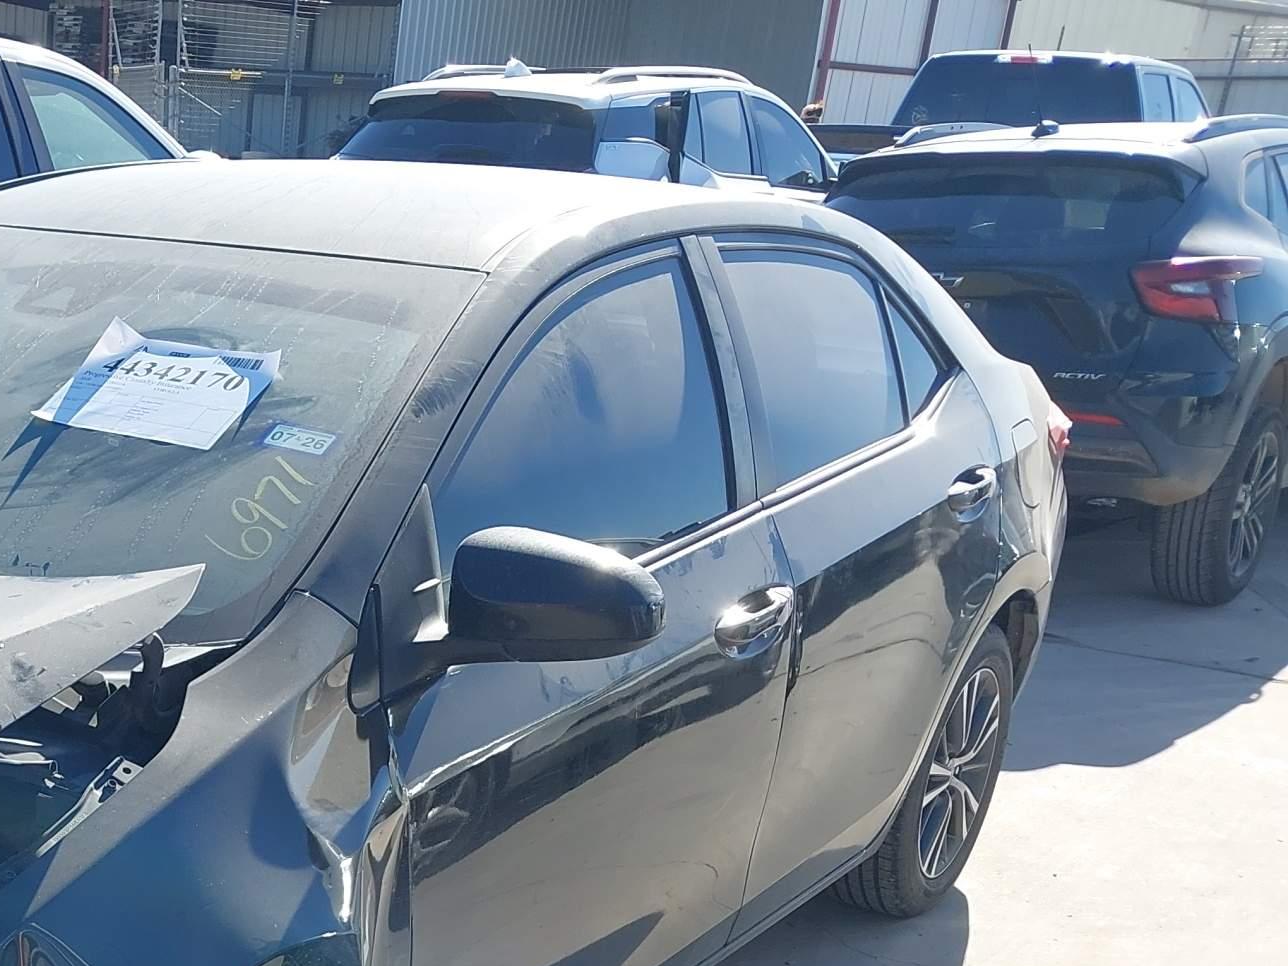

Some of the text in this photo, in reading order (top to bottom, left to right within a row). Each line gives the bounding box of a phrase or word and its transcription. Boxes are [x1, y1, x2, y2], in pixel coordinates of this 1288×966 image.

[103, 357, 245, 392] 44342170
[270, 430, 327, 450] 07 26
[205, 456, 316, 560] 6971
